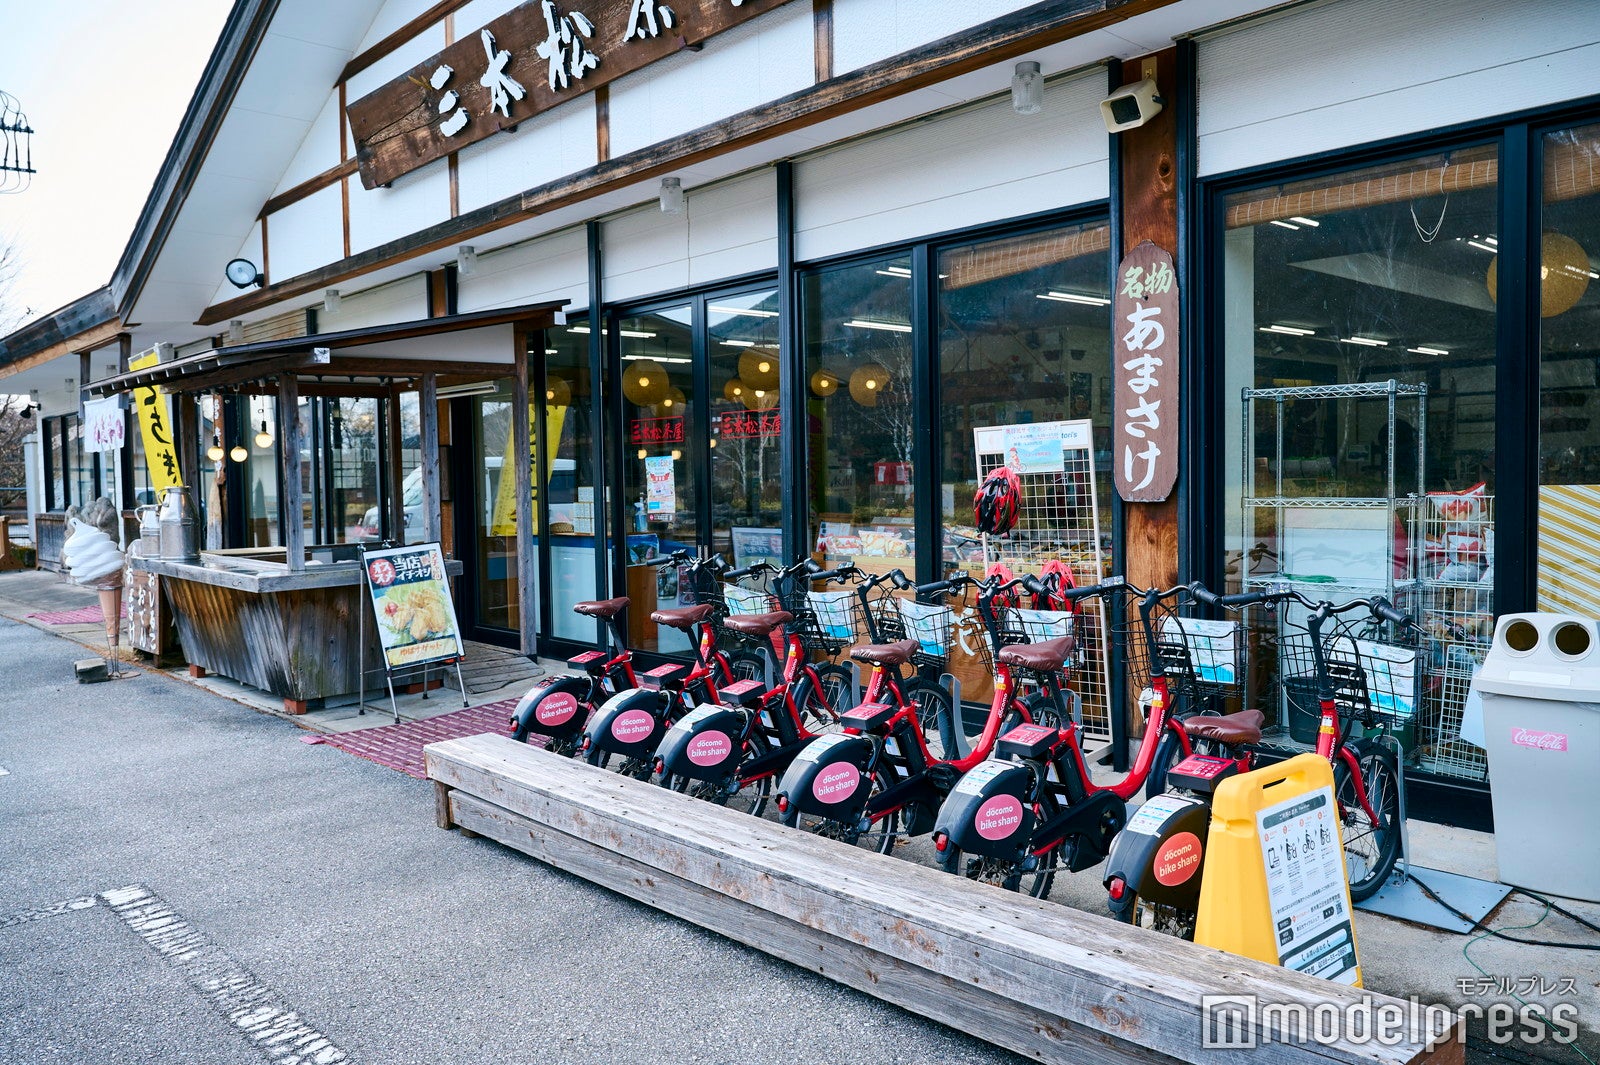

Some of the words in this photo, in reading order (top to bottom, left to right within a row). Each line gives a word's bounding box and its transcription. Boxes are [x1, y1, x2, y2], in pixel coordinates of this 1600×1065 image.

[1120, 262, 1173, 299] 名物
[1123, 301, 1165, 492] あまさけ
[632, 422, 682, 441] 三本松茶屋
[393, 556, 421, 571] 当店
[397, 567, 431, 580] イチオシ
[138, 584, 147, 648] おでん
[541, 708, 556, 720] bike
[555, 705, 573, 718] share
[615, 725, 631, 736] bike
[632, 723, 650, 734] share
[691, 748, 707, 757] bike
[707, 746, 727, 756] share
[818, 783, 835, 797] bike
[835, 778, 856, 792] share
[980, 818, 997, 831] bike
[997, 815, 1018, 827] share
[1159, 861, 1177, 877] bike
[1177, 853, 1198, 871] share
